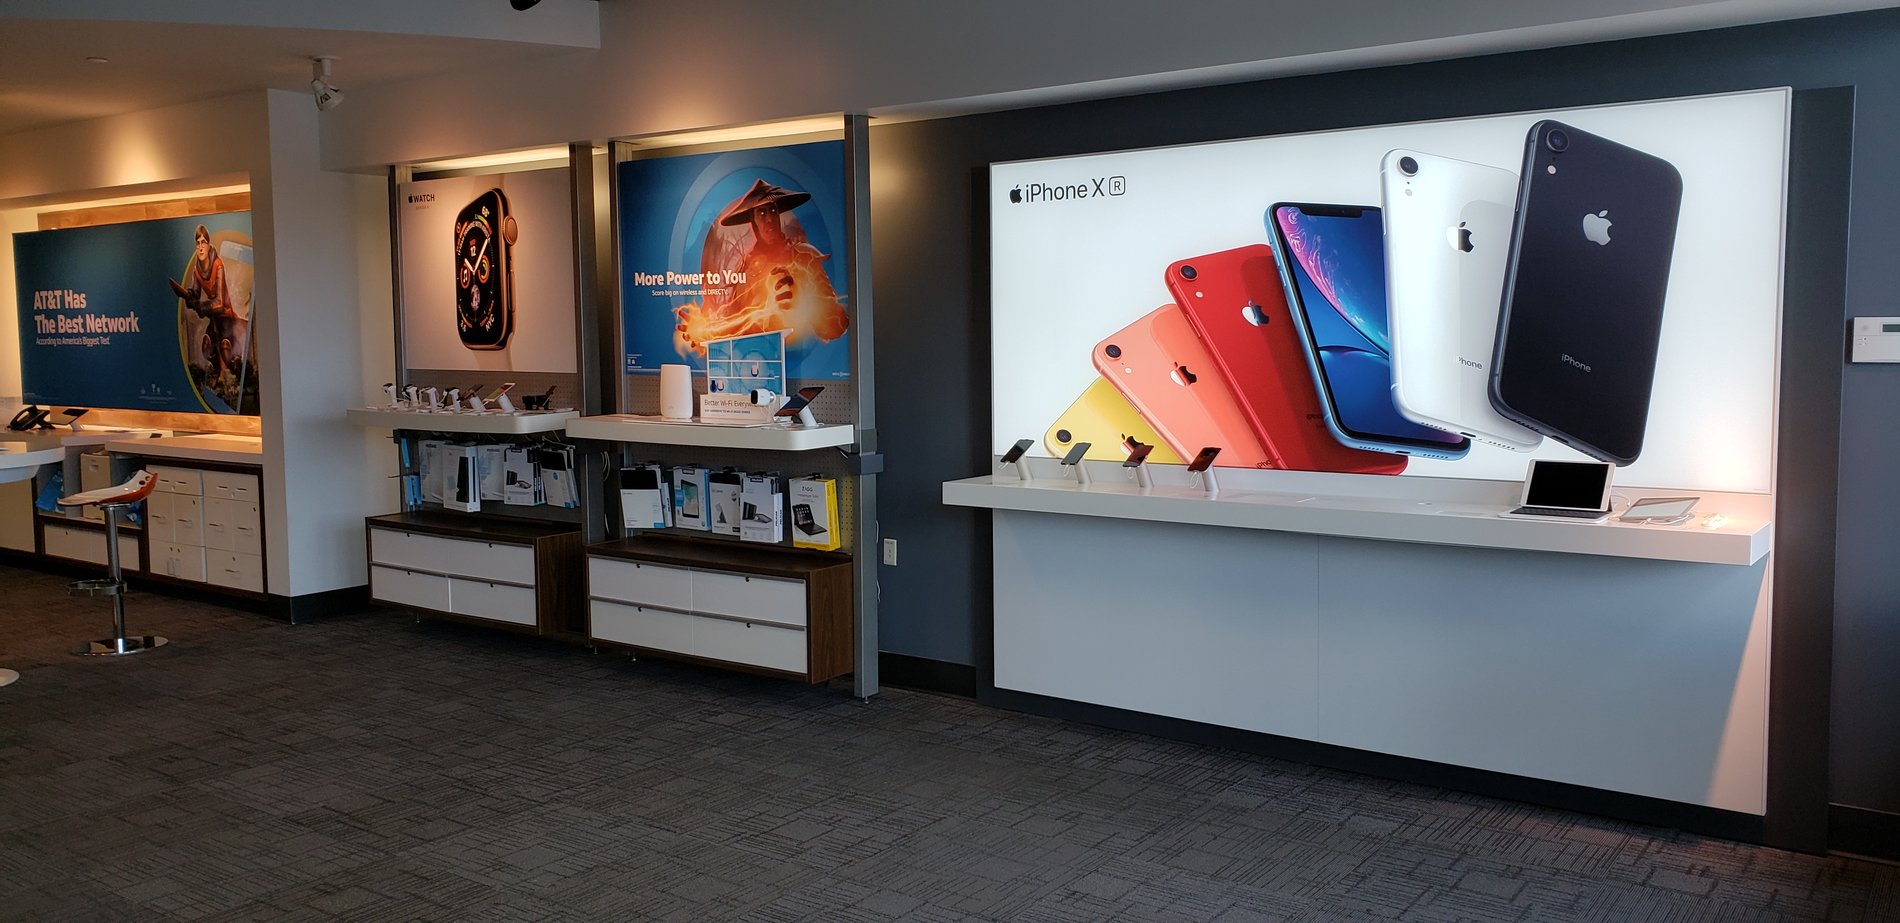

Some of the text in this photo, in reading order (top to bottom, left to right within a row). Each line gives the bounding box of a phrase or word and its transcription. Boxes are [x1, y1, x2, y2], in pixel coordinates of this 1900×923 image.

[413, 193, 436, 203] WATCH
[1025, 183, 1088, 203] iPhone
[1091, 177, 1105, 198] X
[634, 269, 747, 286] More Power to You
[33, 289, 87, 310] AT&T Has
[664, 289, 672, 298] big
[34, 311, 140, 334] The Best Network
[36, 336, 57, 347] According
[57, 337, 62, 345] to
[1561, 353, 1592, 373] iPhone
[704, 399, 719, 407] Better
